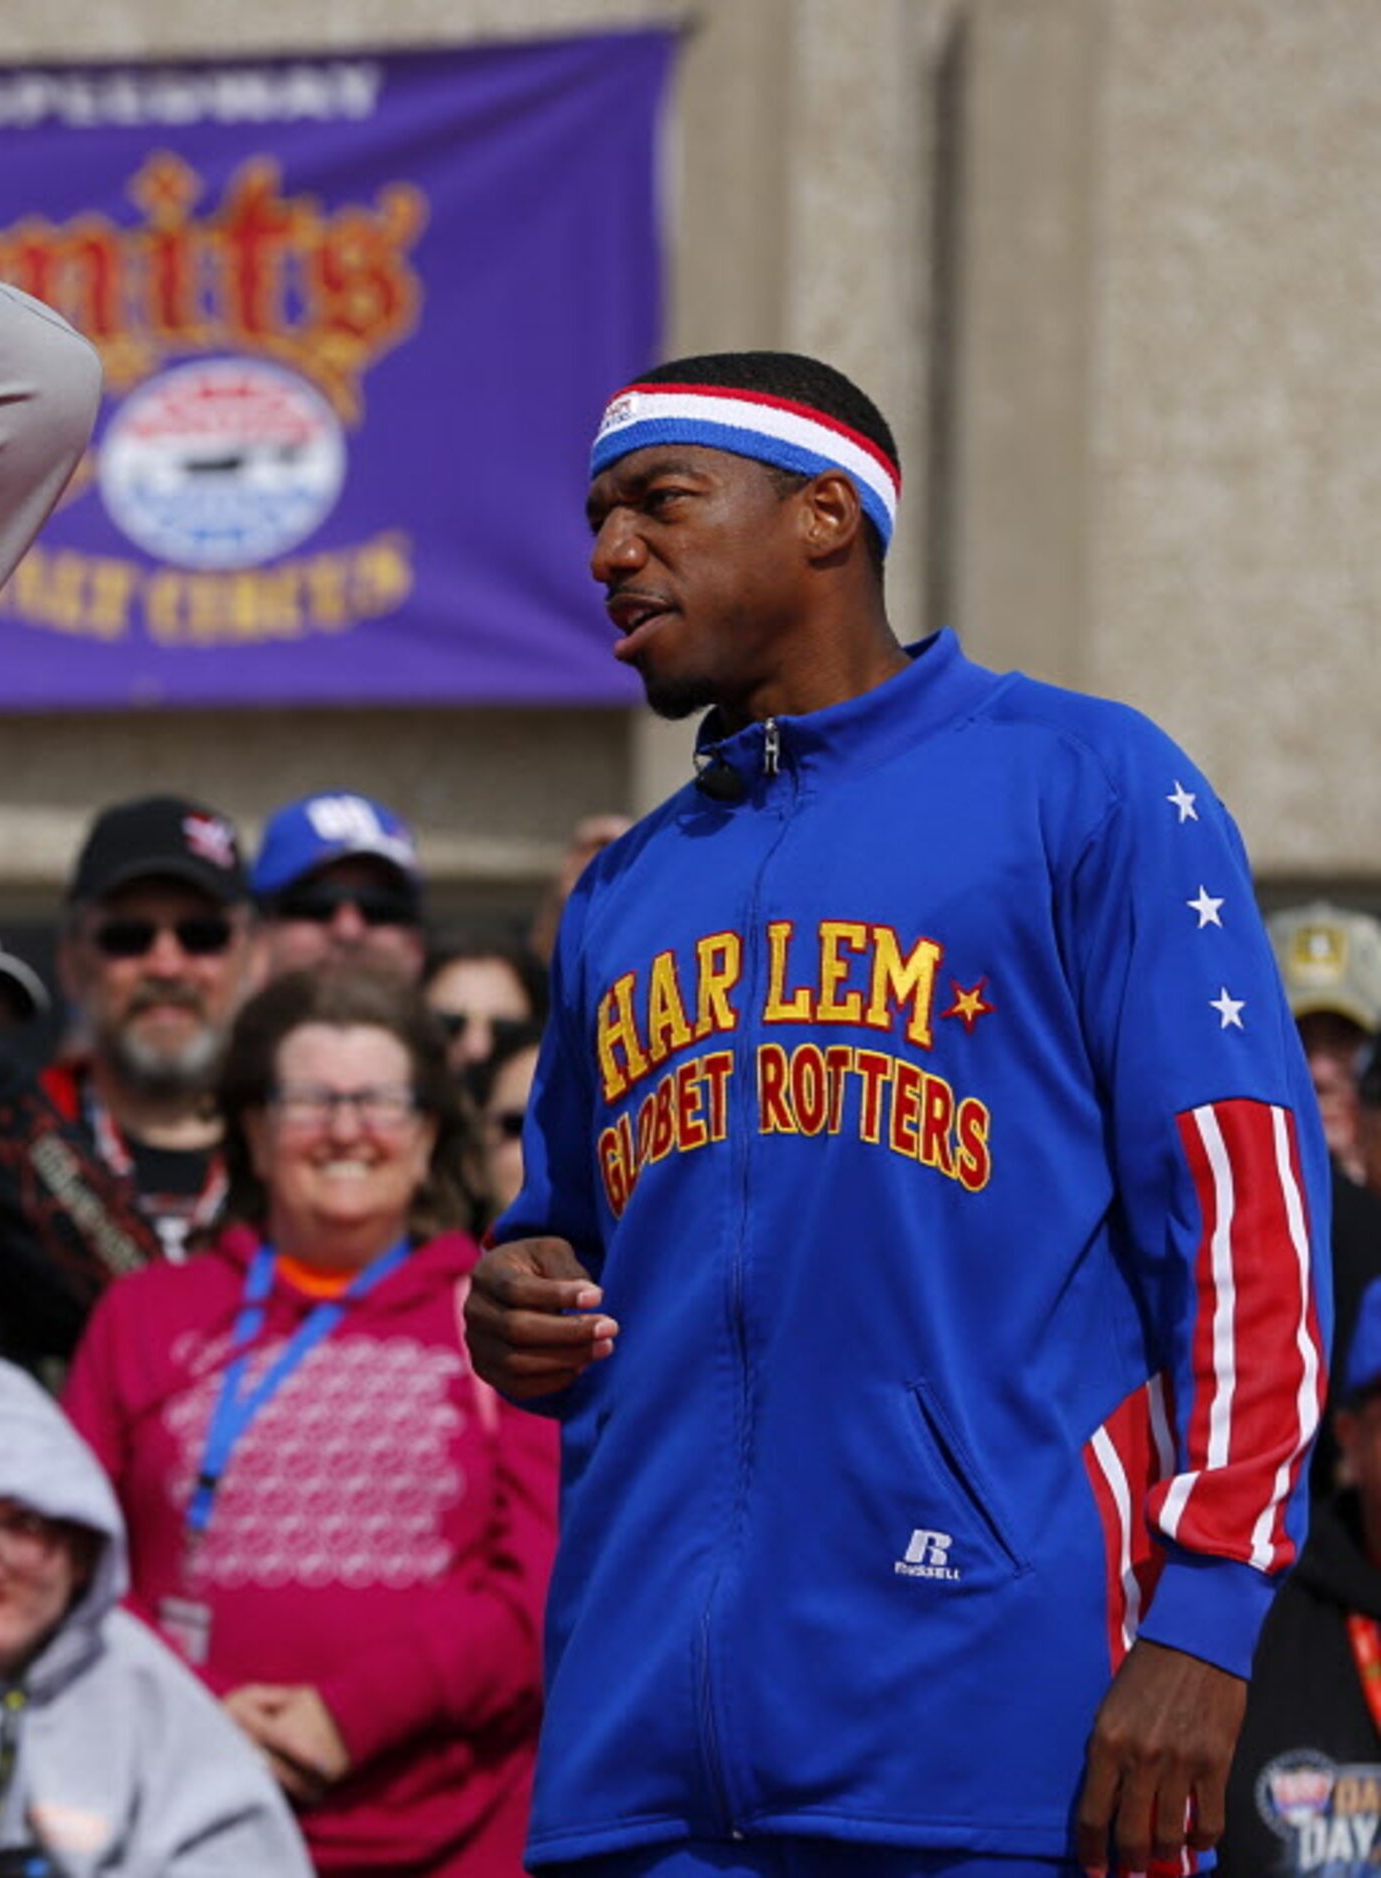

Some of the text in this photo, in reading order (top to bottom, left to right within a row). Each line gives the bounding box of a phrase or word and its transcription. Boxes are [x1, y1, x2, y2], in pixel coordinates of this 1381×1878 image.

[595, 918, 945, 1106] HARLEM
[597, 1042, 993, 1221] GLOBETROTTERS
[894, 1560, 962, 1582] RUSSELL
